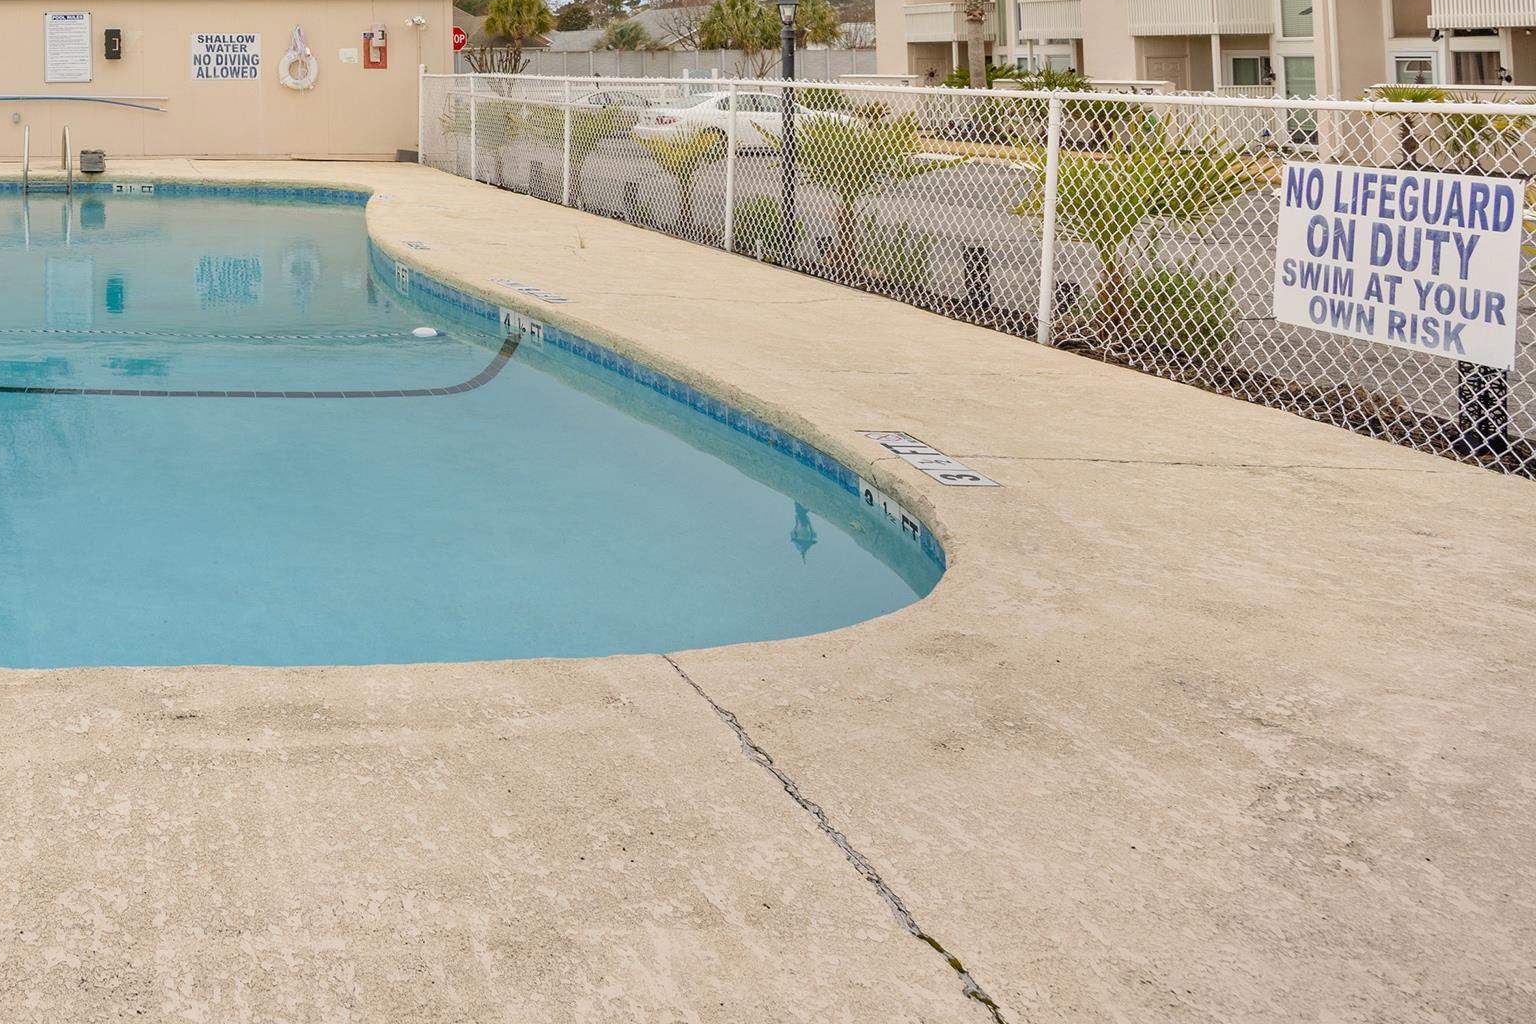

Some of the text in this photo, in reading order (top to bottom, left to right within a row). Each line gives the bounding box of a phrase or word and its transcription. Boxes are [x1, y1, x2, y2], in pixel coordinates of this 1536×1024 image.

[197, 35, 255, 43] SHALLOW
[454, 34, 465, 43] OP
[205, 44, 247, 52] WATER
[193, 54, 260, 66] NO DIVING
[196, 67, 258, 78] ALLOWED
[1285, 166, 1515, 233] NO LIFEGUARD
[1306, 214, 1481, 280] ON DUTY
[1282, 258, 1506, 326] SWIM AT YOUR
[1309, 295, 1467, 356] OWN RISK
